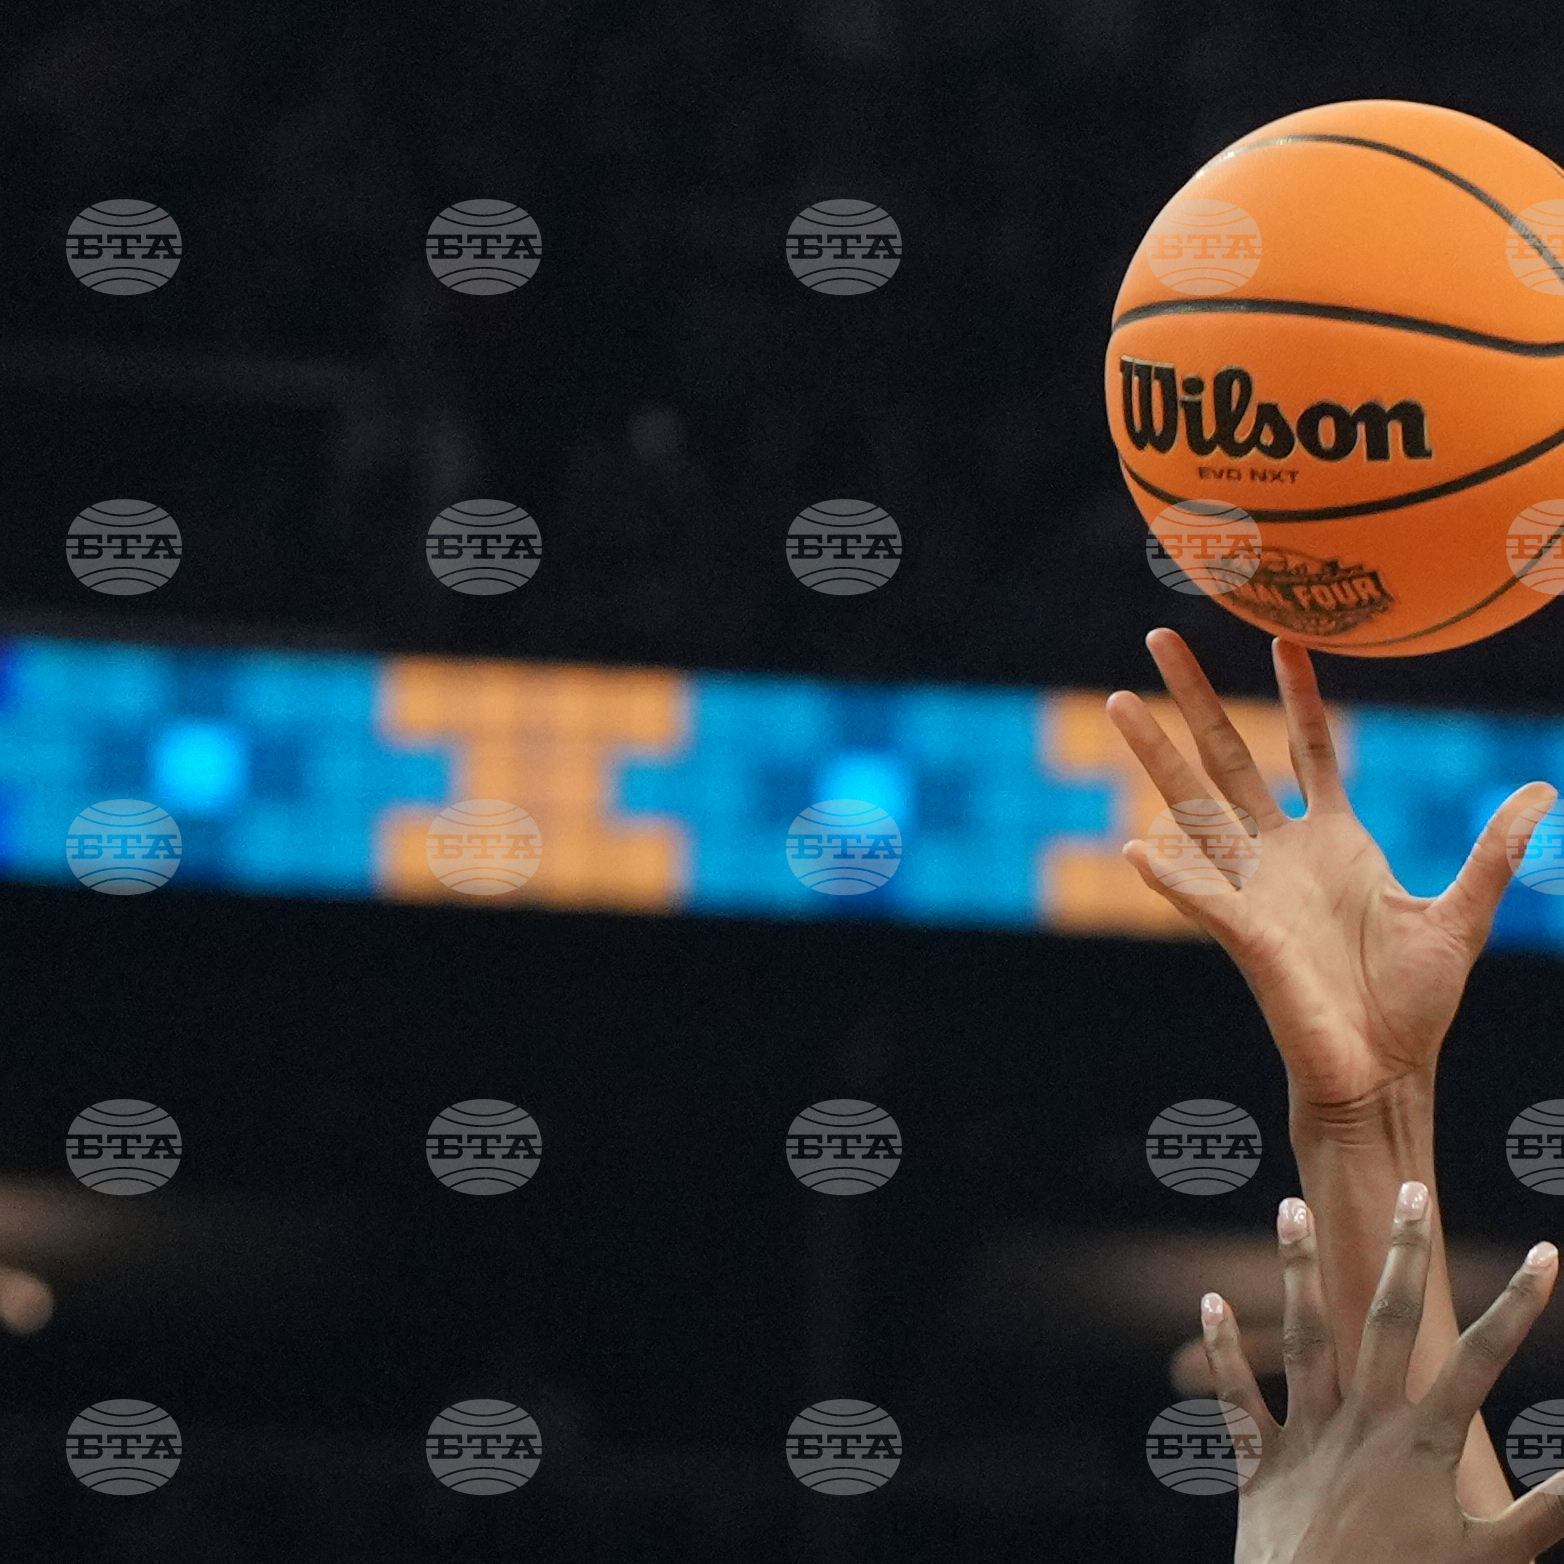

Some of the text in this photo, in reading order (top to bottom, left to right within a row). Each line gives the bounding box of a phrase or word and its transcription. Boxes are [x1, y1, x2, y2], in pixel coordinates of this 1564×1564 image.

[1120, 355, 1432, 461] Wilson
[1249, 468, 1299, 484] NXT
[1292, 576, 1382, 611] FOUR
